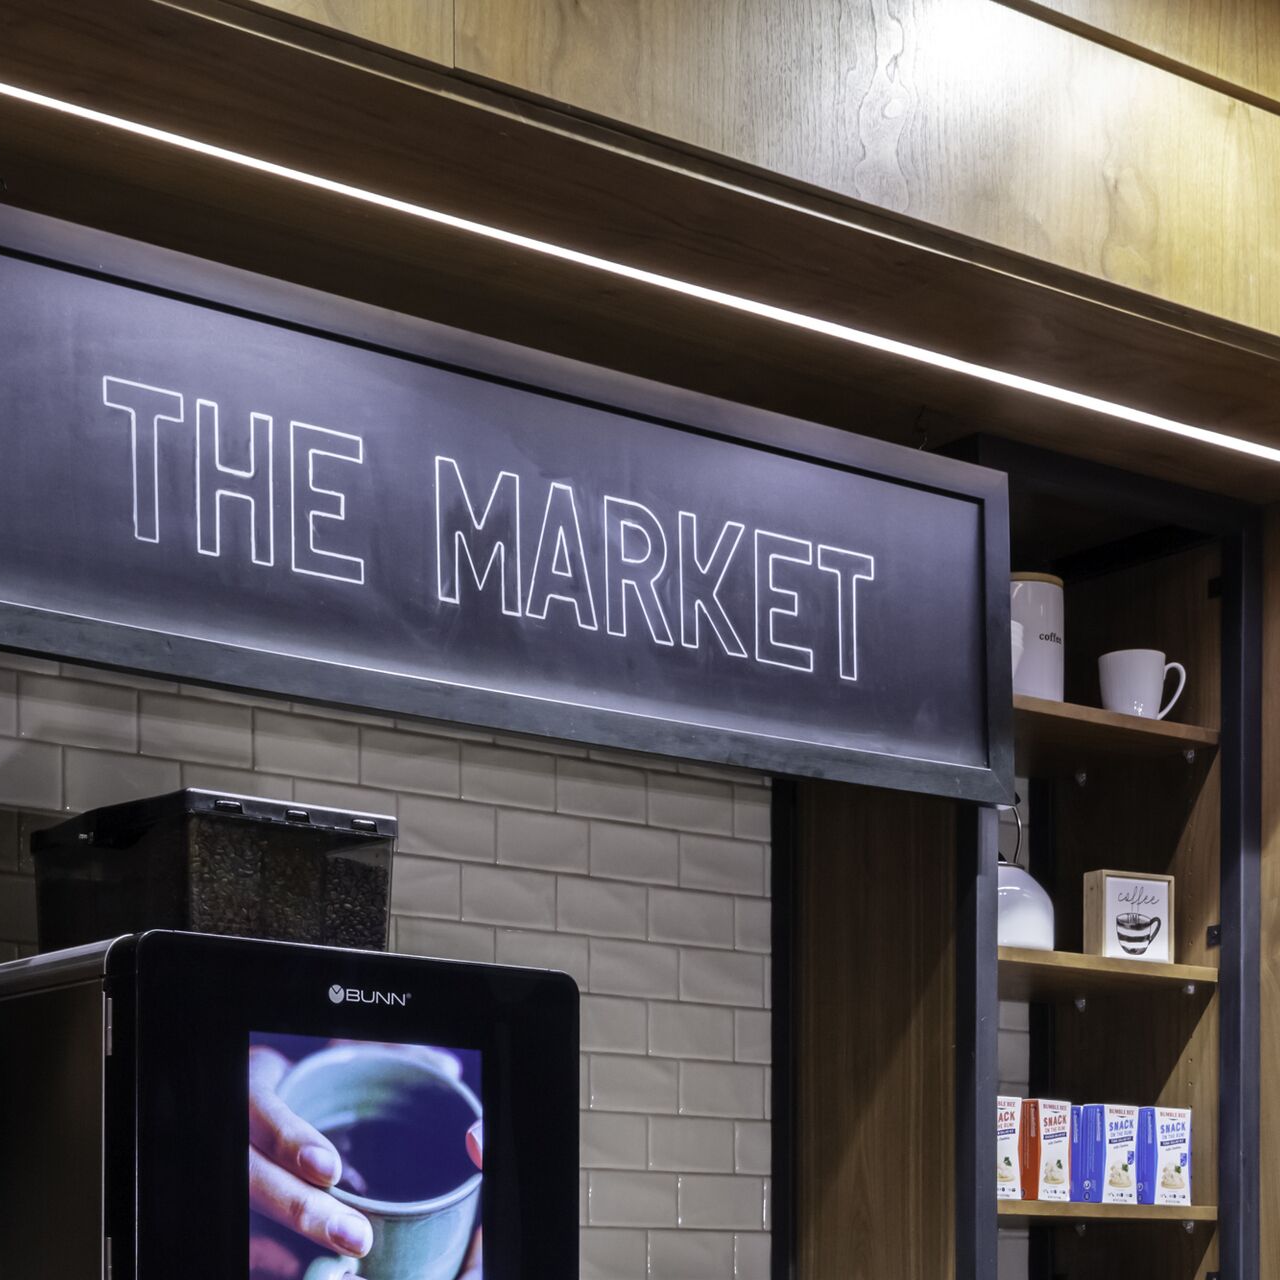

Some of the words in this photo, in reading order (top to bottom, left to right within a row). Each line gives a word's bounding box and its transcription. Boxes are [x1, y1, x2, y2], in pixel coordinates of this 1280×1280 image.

[102, 375, 366, 585] THE
[434, 455, 876, 681] MARKET
[1117, 886, 1160, 906] coffee
[345, 988, 406, 1007] BUNN
[1043, 1115, 1067, 1127] SNACK
[1109, 1120, 1134, 1132] SNACK
[1160, 1122, 1186, 1134] SNACK
